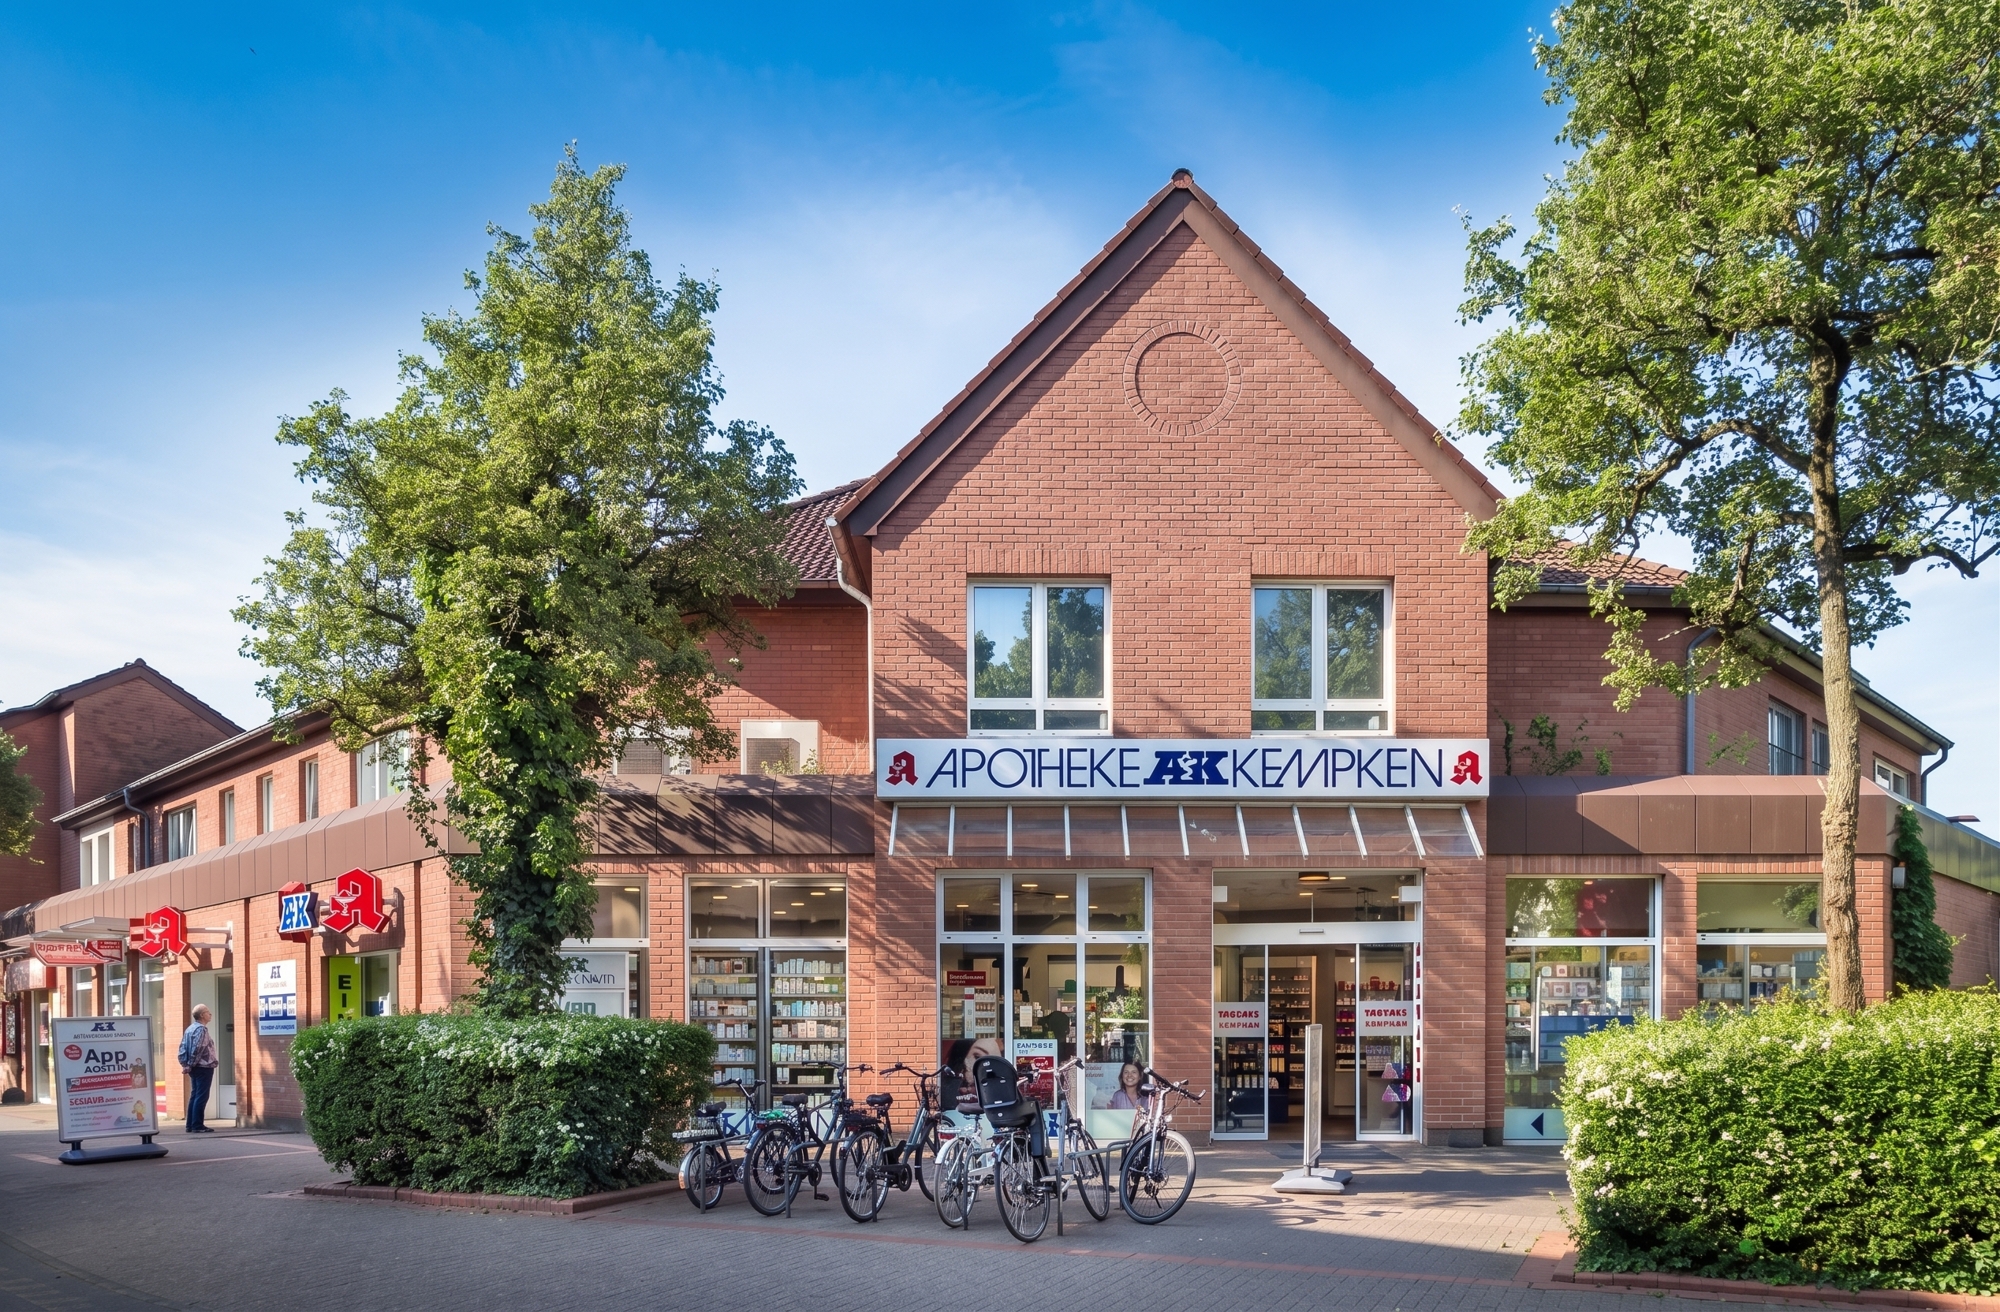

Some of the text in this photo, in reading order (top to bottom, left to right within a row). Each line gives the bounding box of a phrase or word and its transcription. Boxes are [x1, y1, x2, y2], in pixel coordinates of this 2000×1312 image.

[925, 747, 1141, 788] APOTHEKE
[1232, 747, 1443, 788] KEMPKEN
[84, 1048, 127, 1065] App
